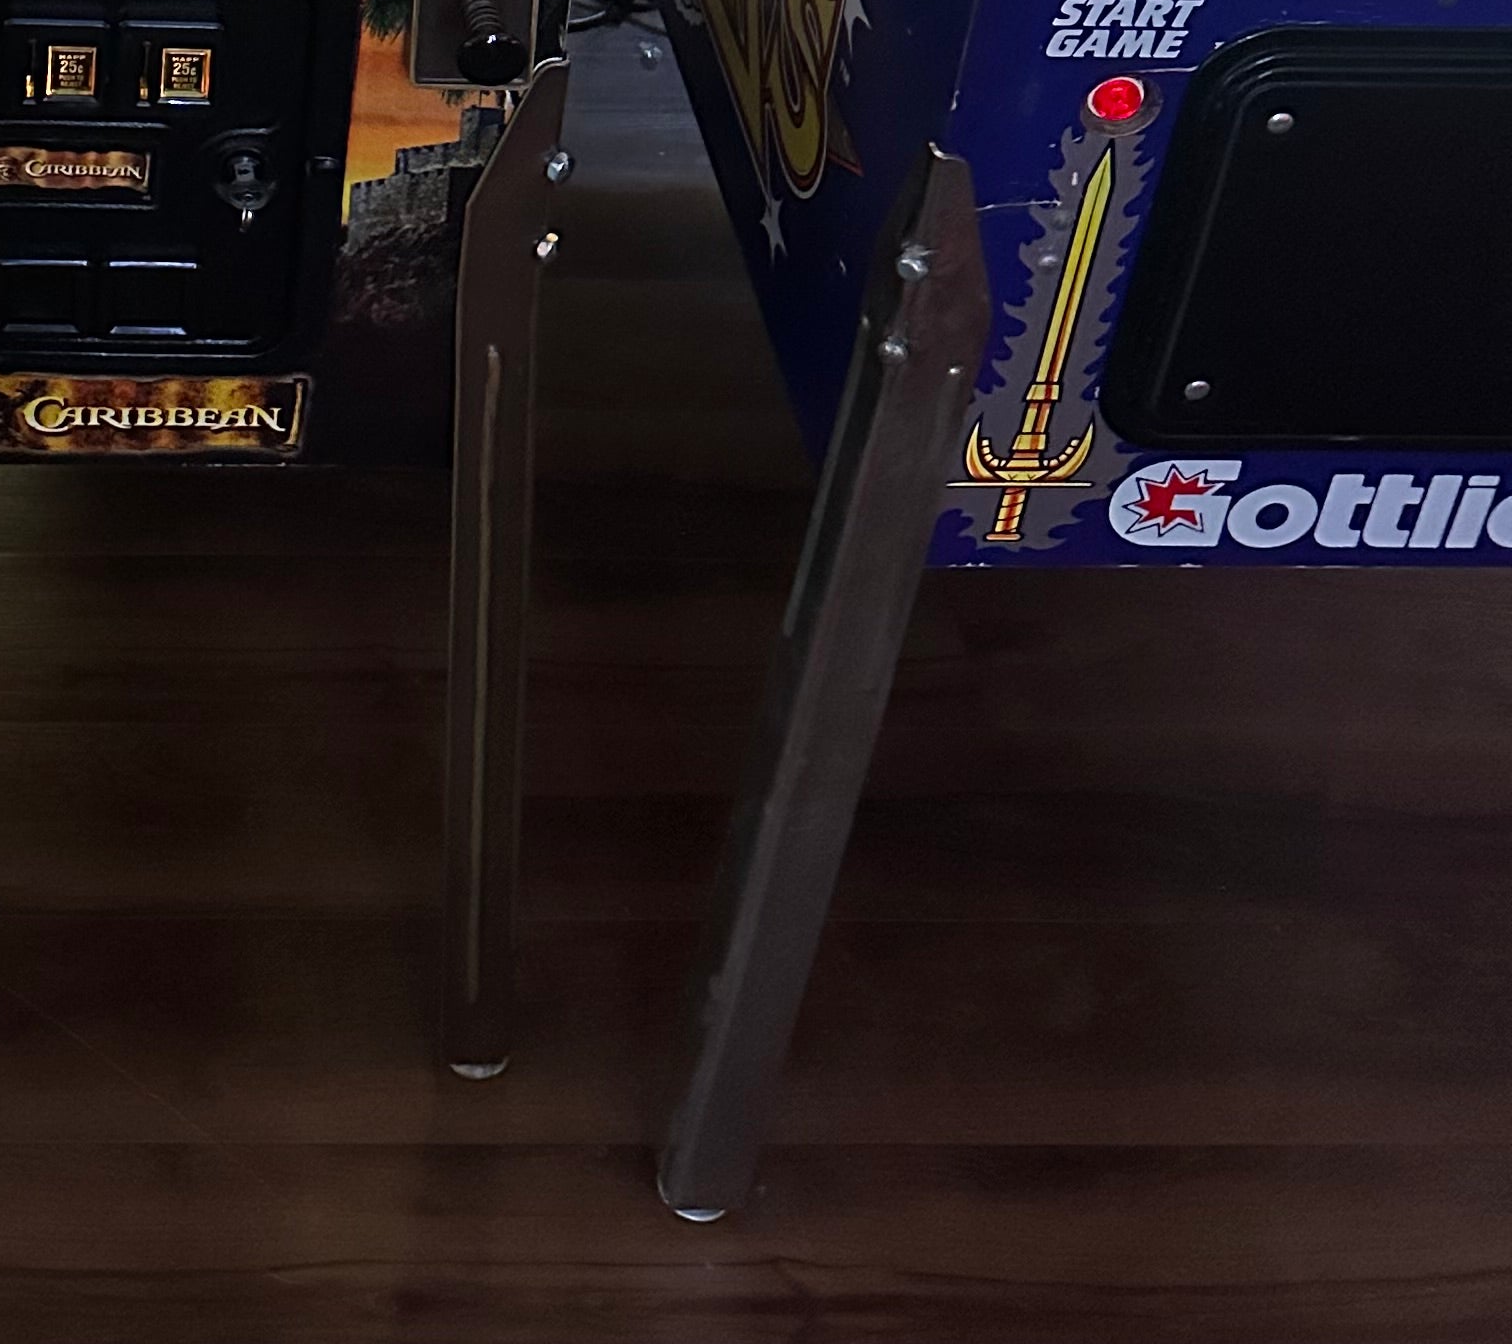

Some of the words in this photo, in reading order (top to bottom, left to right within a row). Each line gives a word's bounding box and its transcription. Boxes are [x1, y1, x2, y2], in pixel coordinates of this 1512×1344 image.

[1046, 28, 1190, 59] GAME
[24, 158, 143, 180] CARIBBEAN
[22, 396, 286, 433] CARIBBEAN
[1109, 460, 1512, 548] Gottli
